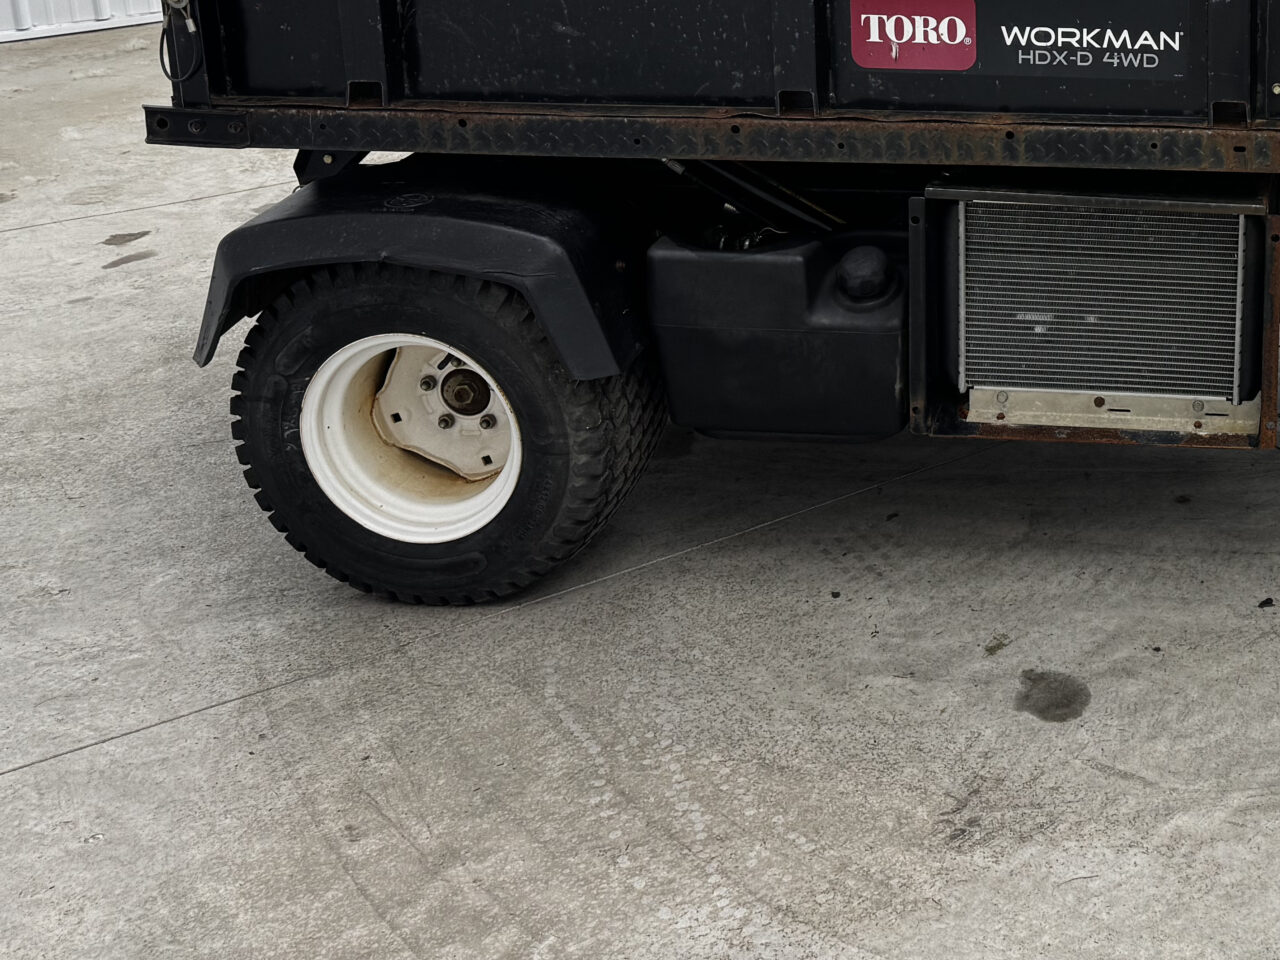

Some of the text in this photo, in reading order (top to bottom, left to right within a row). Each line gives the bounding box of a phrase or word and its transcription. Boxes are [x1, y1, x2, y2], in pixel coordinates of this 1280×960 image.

[860, 13, 967, 45] TORO
[1000, 25, 1181, 52] WORKMAN
[1018, 49, 1160, 68] HDX-D 4WD
